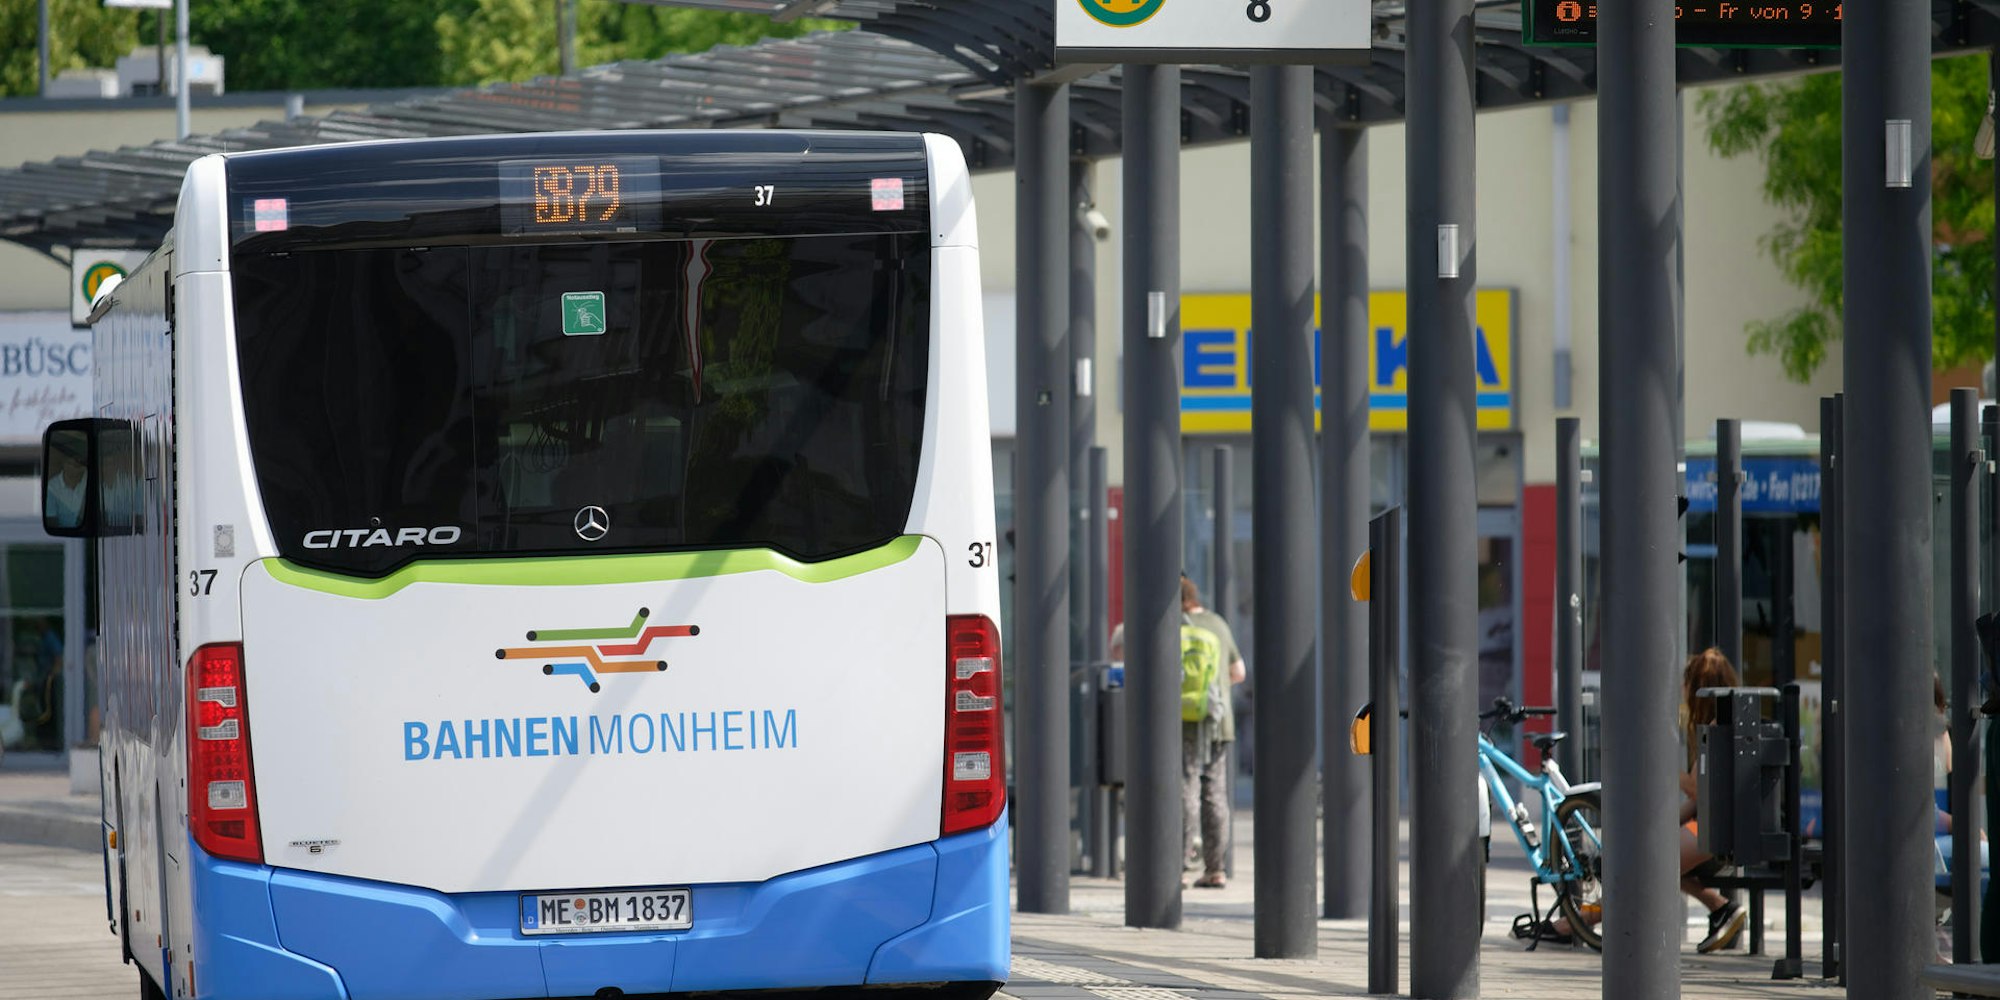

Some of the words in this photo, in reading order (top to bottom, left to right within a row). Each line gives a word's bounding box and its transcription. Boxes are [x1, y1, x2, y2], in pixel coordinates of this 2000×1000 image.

[1246, 0, 1272, 23] 8
[1720, 3, 1738, 19] Fr
[1750, 7, 1788, 19] von
[1800, 4, 1812, 19] 9
[754, 185, 774, 206] 37
[303, 525, 461, 549] CITARO
[968, 541, 992, 568] 37
[189, 568, 218, 597] 37
[403, 716, 579, 761] BAHNEN
[589, 708, 799, 755] MONHEIM
[541, 899, 572, 925] ME
[589, 897, 619, 924] BM
[626, 895, 685, 922] 1837
